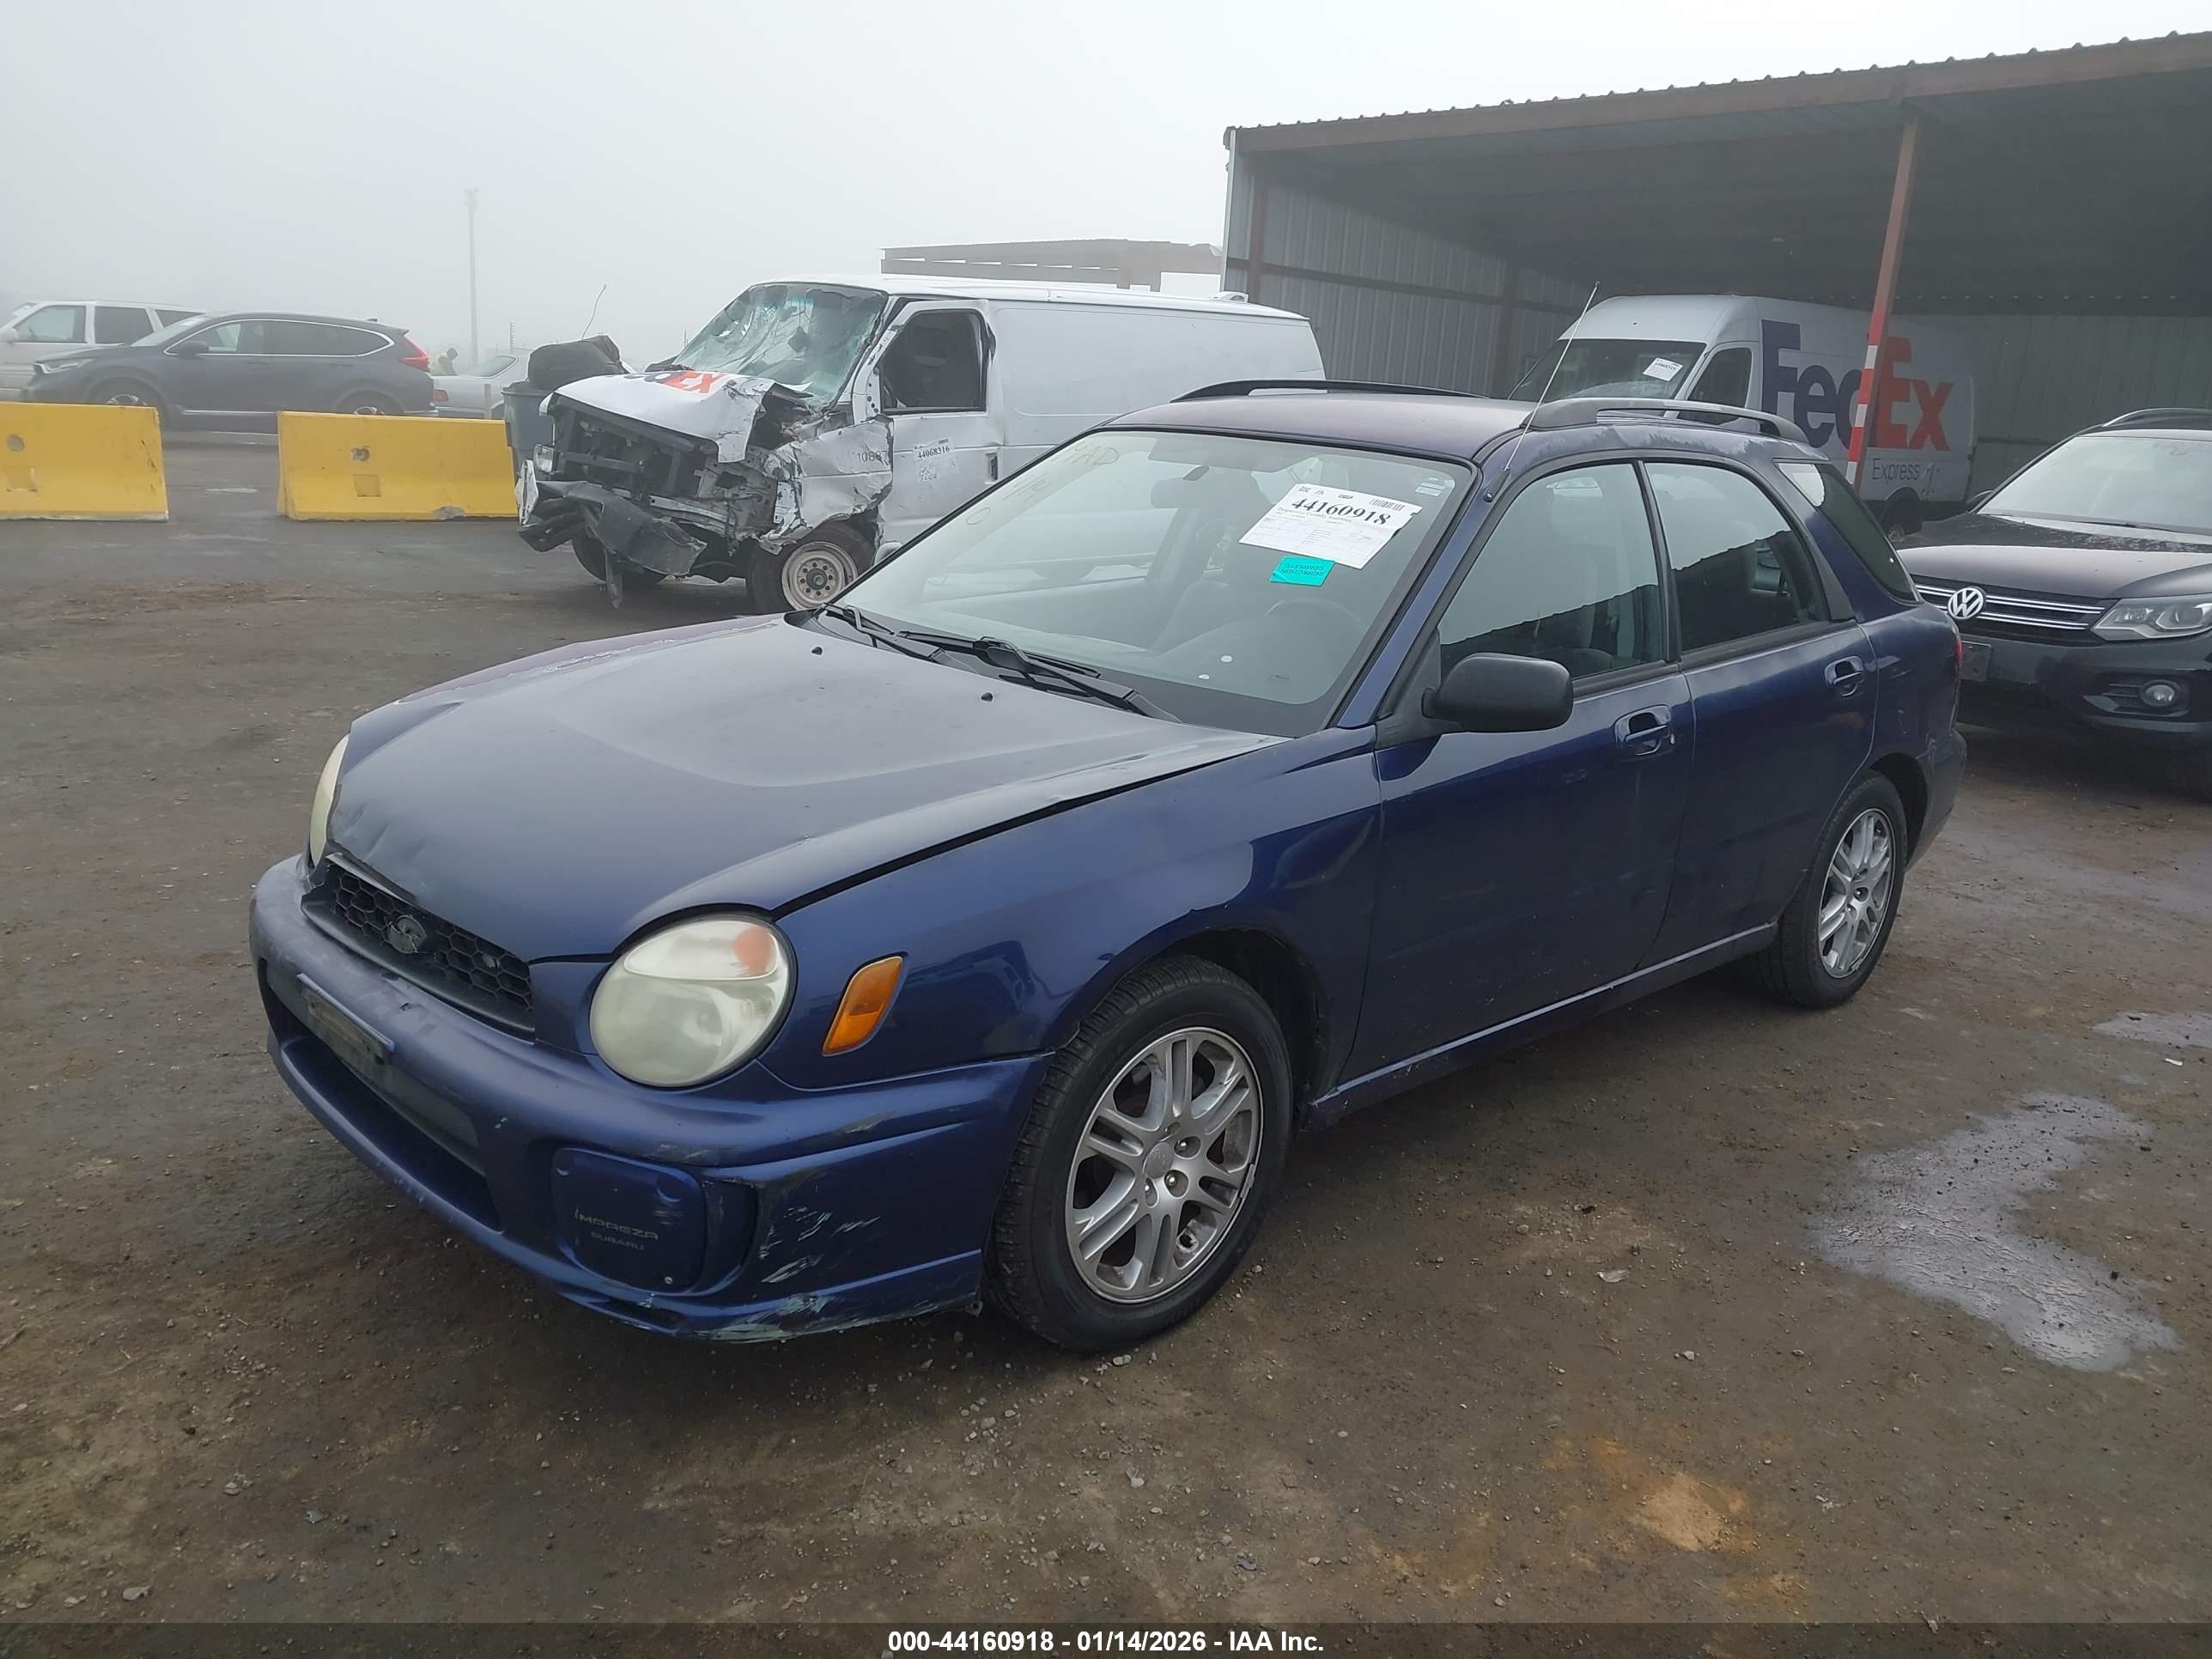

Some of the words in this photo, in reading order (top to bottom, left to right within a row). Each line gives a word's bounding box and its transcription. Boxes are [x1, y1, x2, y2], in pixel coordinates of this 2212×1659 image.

[623, 370, 726, 393] dEx
[917, 445, 950, 459] 44068316
[1871, 458, 1921, 483] Express
[1291, 498, 1392, 526] 44160918
[1949, 587, 1984, 619] VW
[574, 1208, 659, 1241] IMPREZA
[590, 1231, 645, 1251] SUBARU
